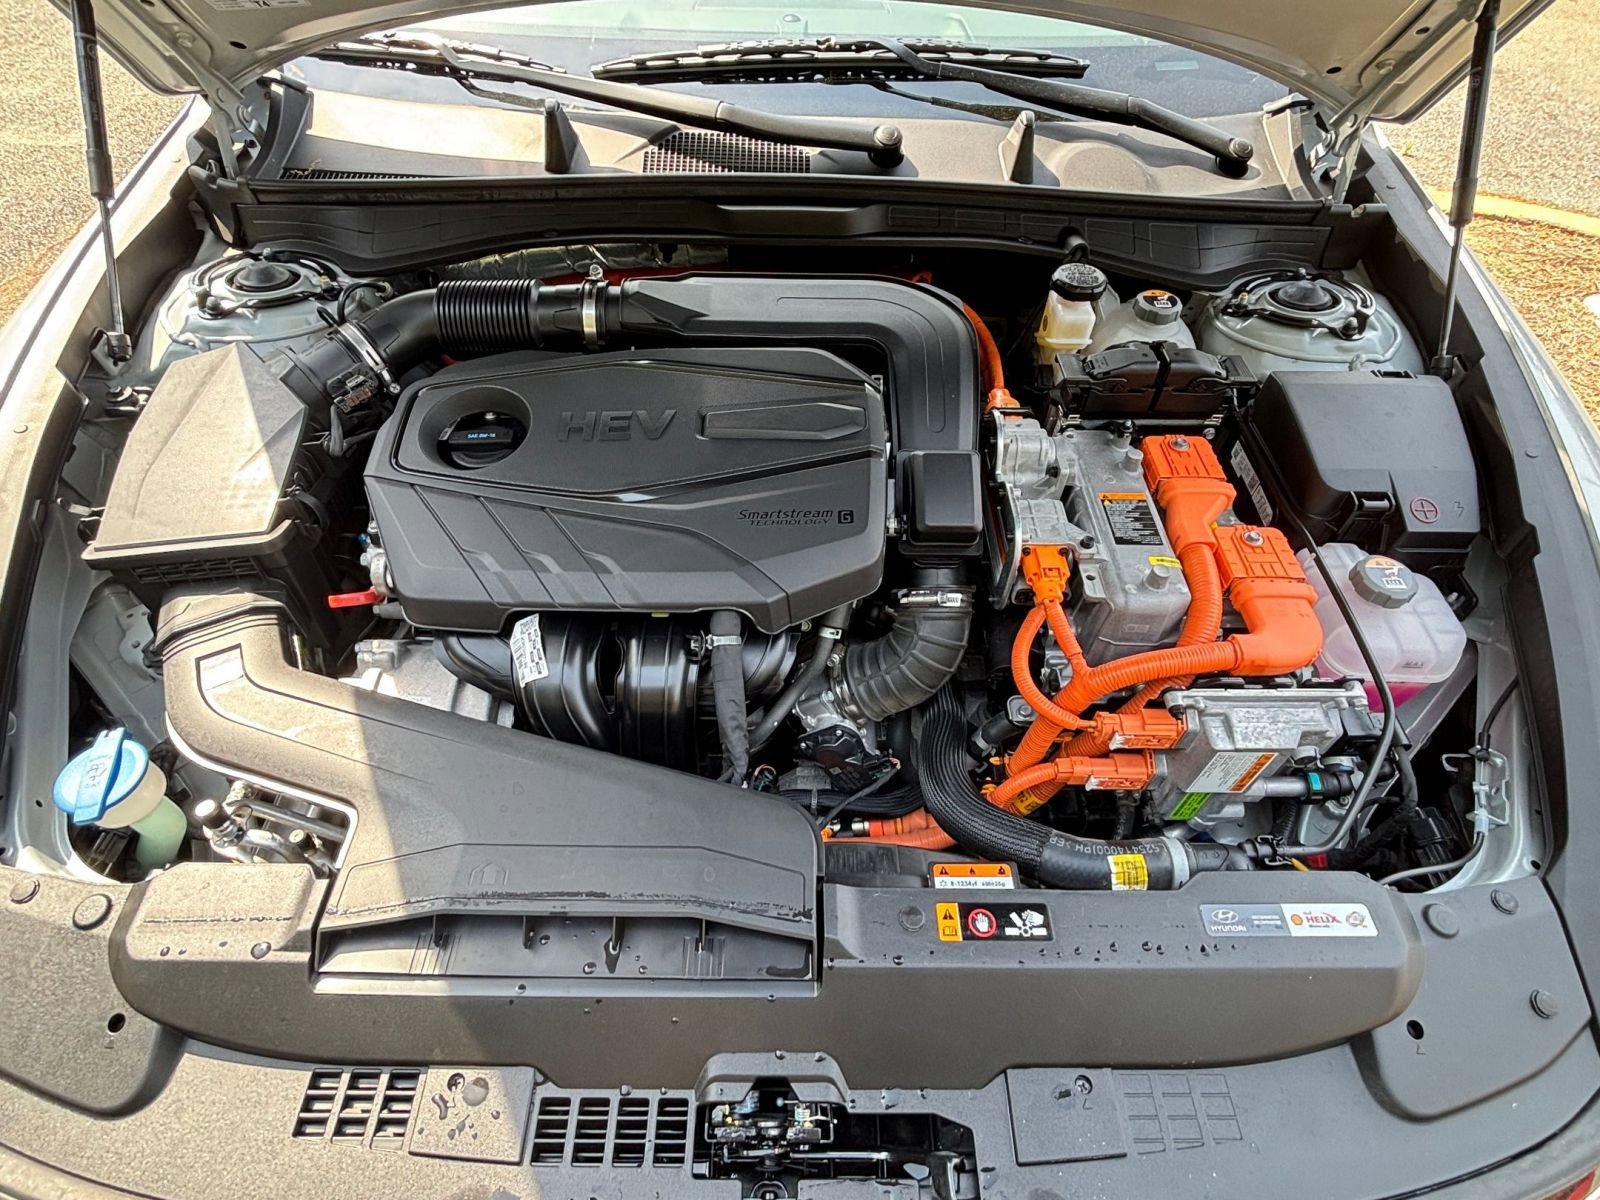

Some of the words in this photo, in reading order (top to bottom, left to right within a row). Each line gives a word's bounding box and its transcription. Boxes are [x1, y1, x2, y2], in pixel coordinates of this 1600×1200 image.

[559, 409, 677, 442] HEV
[738, 508, 834, 520] Smartstream
[1305, 914, 1341, 924] HELIX
[1210, 924, 1248, 933] HYUNDAI
